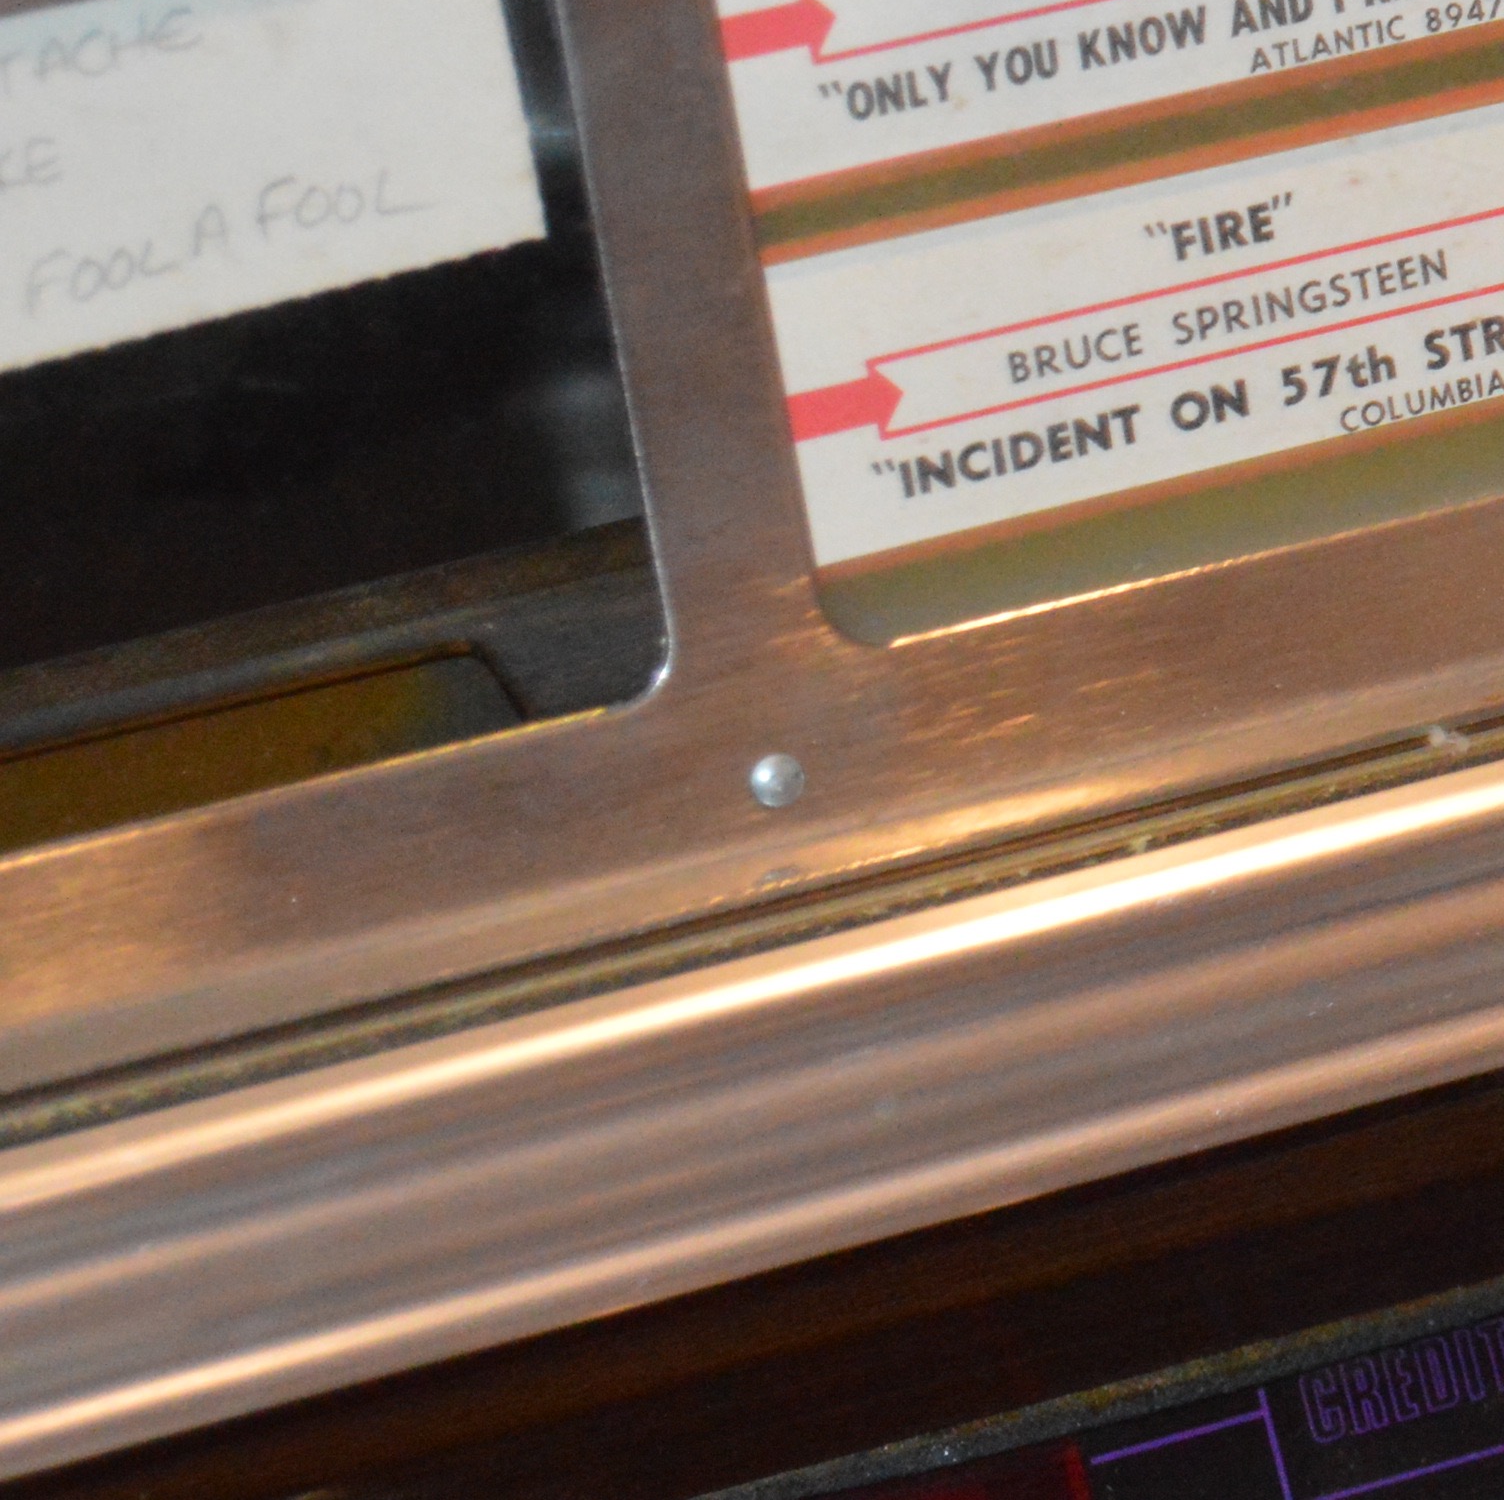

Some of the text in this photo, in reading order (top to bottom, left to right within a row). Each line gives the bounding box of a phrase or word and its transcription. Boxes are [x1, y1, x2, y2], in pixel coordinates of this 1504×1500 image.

[819, 61, 951, 122] "ONLY
[975, 41, 1060, 95] YOU
[1080, 12, 1208, 72] KNOW
[1250, 15, 1407, 74] ATLANTIC
[25, 169, 429, 319] FOOL A FOOL
[1144, 192, 1294, 264] "FIRE"
[1008, 250, 1449, 386] BRUCE SPRINGSTEEN
[871, 404, 1143, 500] "INCIDENT
[1171, 378, 1249, 434] ON
[1282, 347, 1397, 408] 57th
